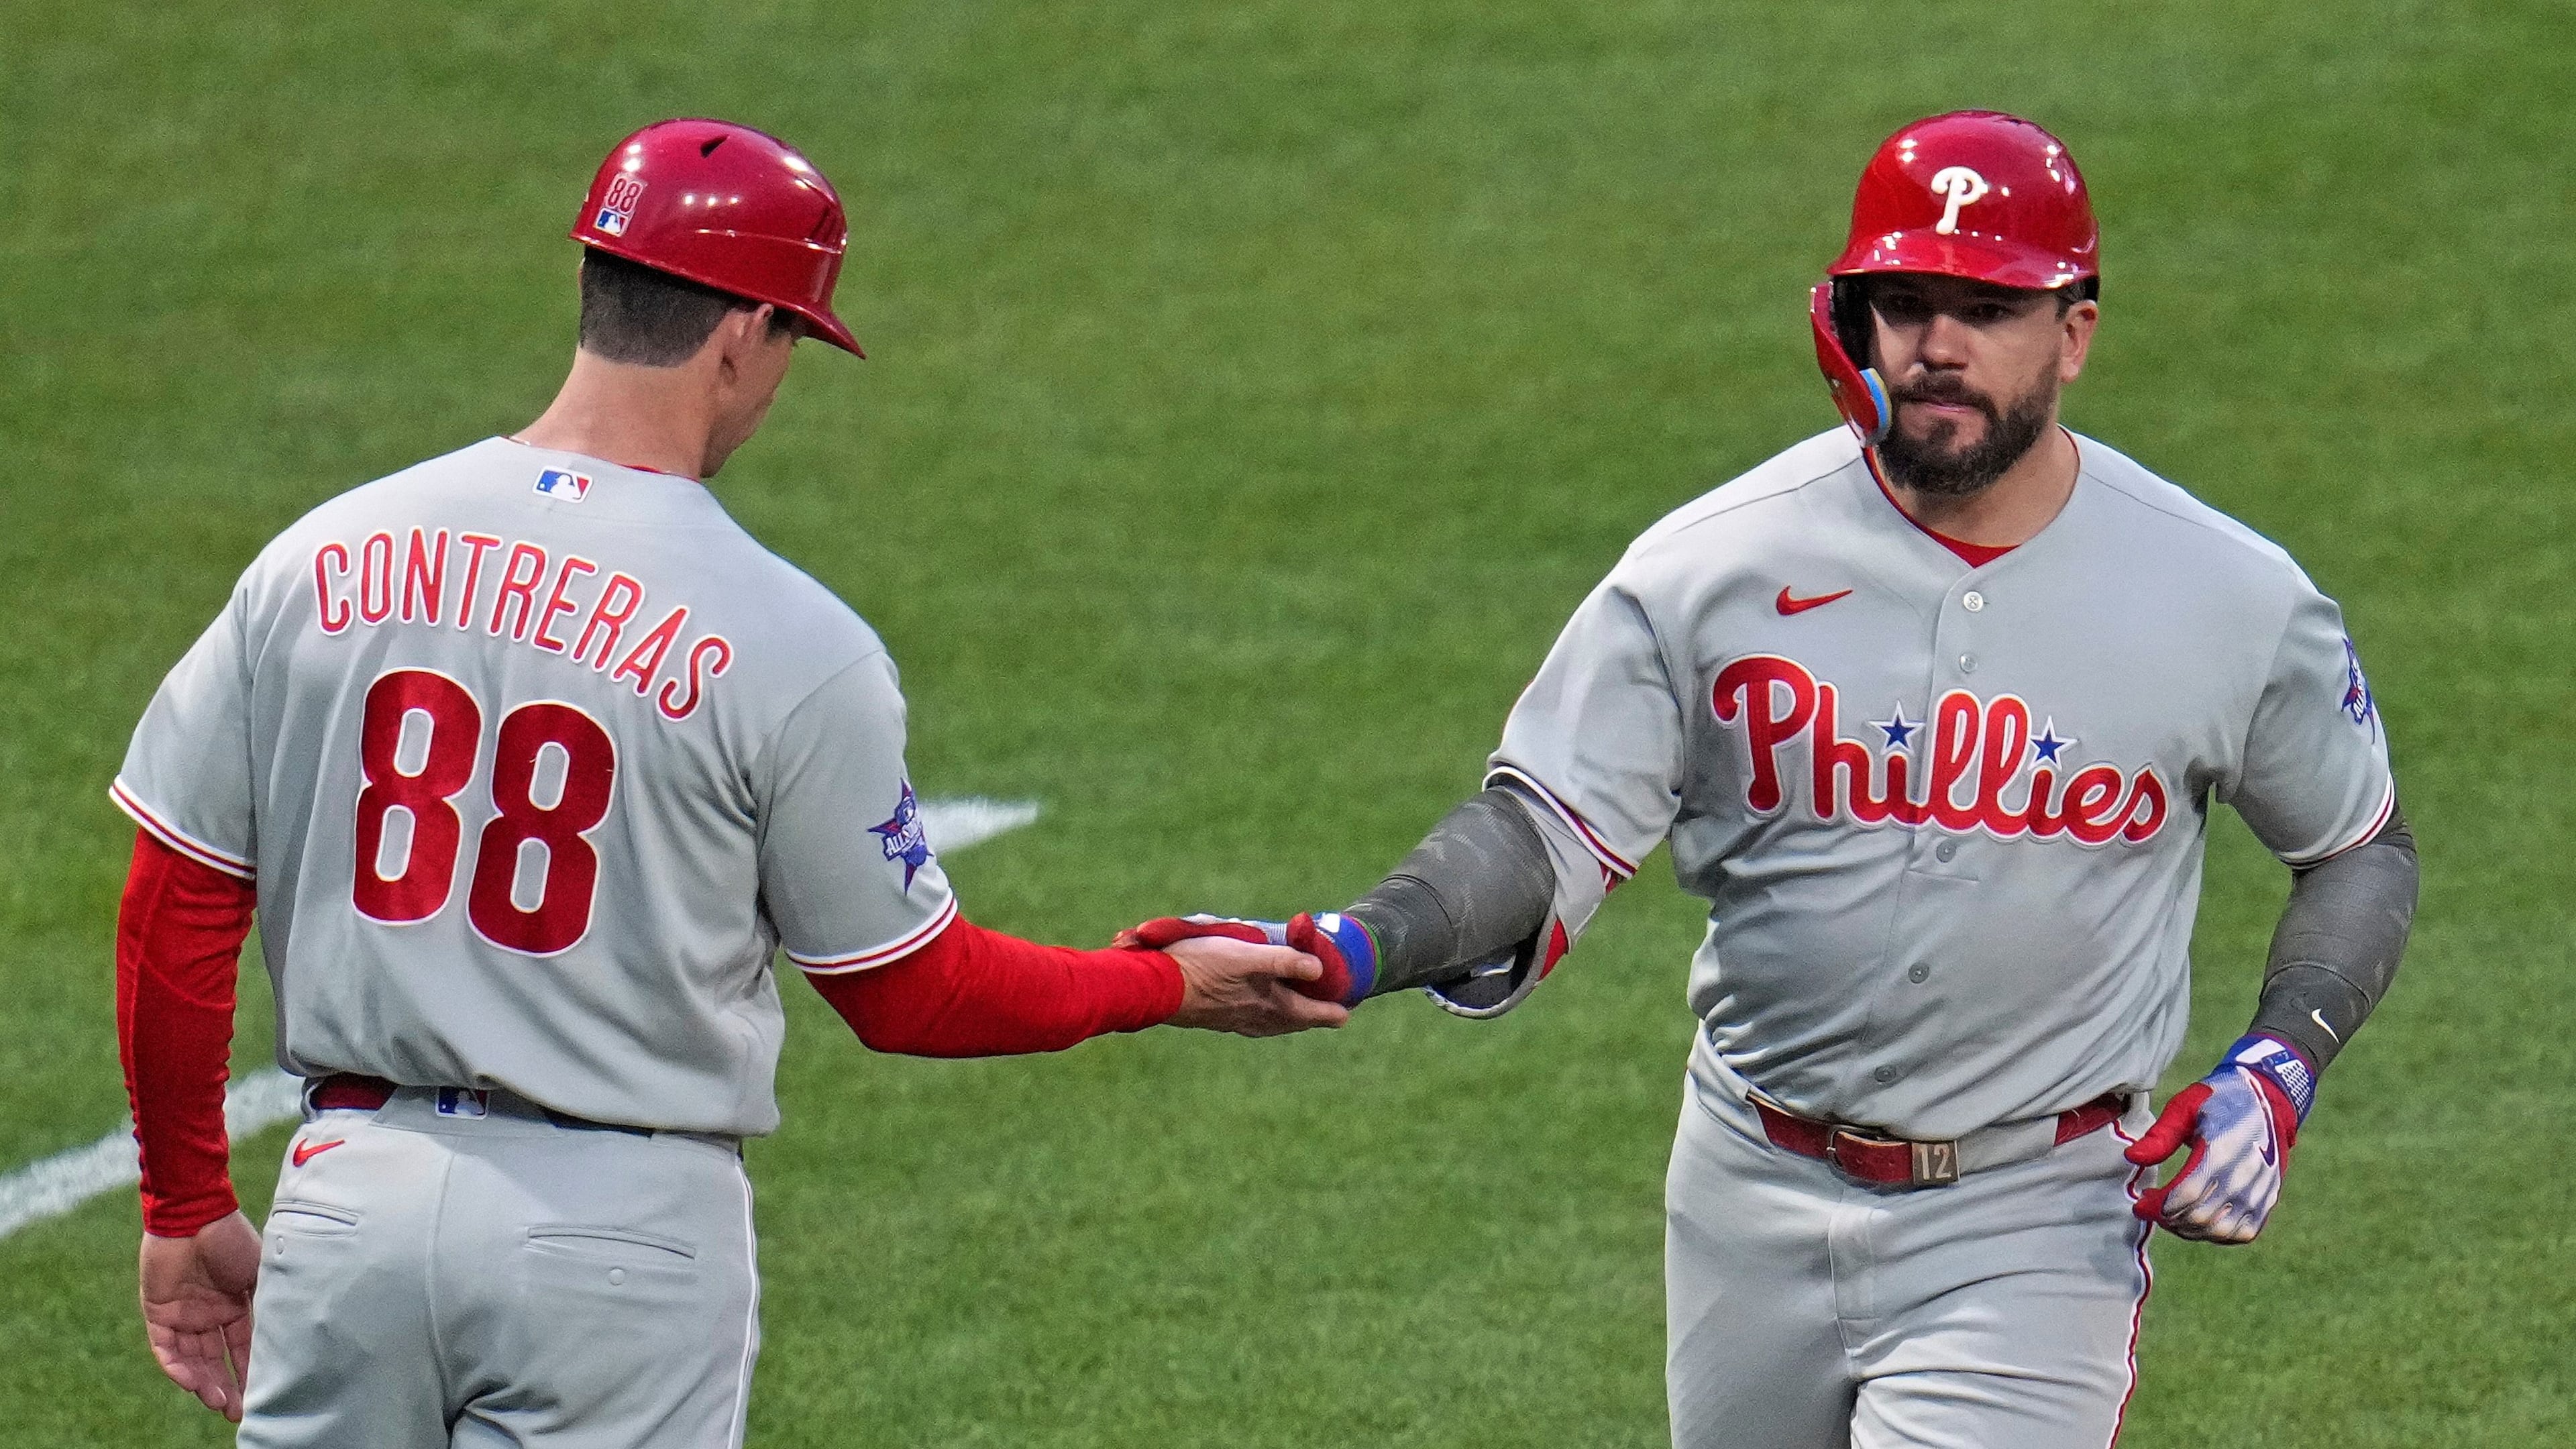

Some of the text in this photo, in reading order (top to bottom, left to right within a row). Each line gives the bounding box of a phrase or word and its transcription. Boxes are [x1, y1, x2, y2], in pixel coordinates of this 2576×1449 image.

[606, 176, 642, 213] 88
[1931, 166, 1988, 235] P
[313, 526, 733, 721] CONTRERAS
[352, 666, 619, 957] 88
[1711, 653, 2168, 850] Phillies
[1912, 1143, 1951, 1181] 12
